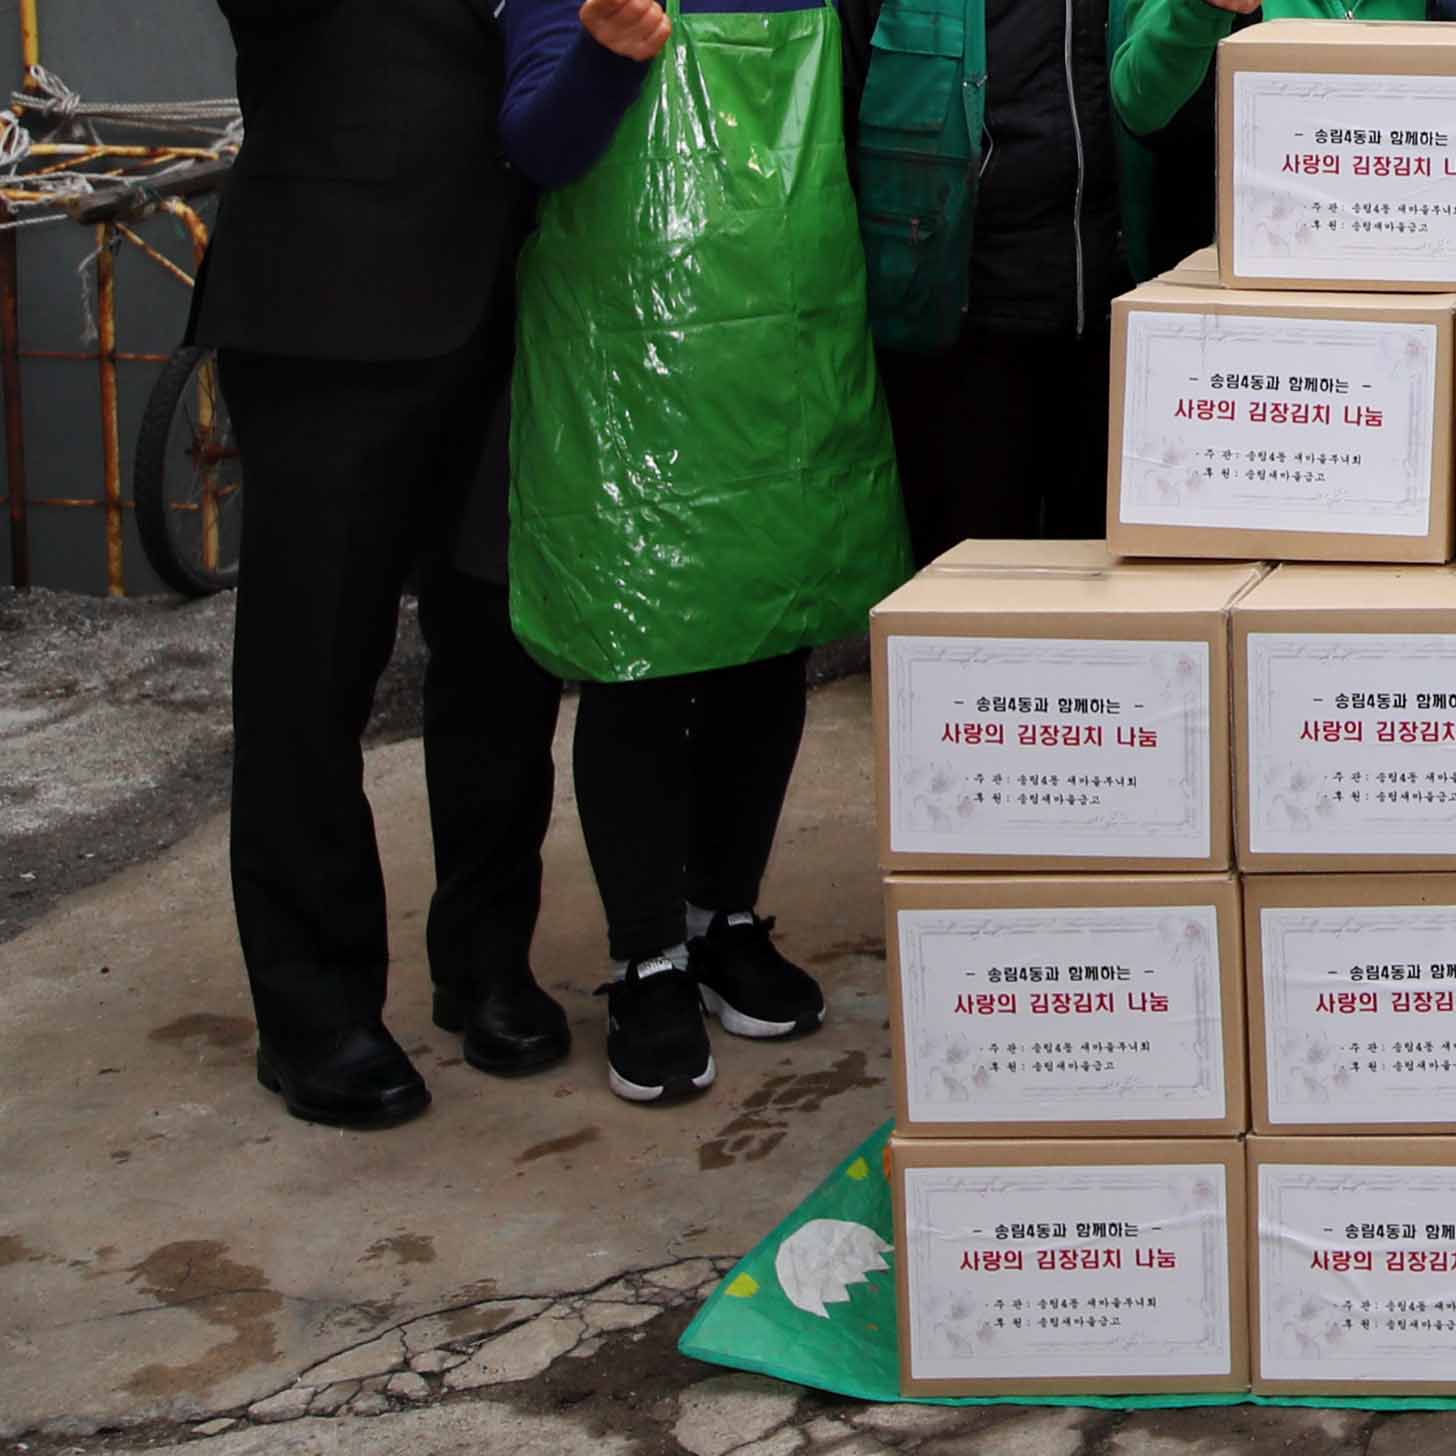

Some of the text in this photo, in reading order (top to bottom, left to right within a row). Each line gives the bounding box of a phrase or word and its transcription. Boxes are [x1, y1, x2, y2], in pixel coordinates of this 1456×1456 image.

[1282, 154, 1339, 174] 사랑의
[1353, 156, 1430, 176] 김장김치
[1177, 399, 1382, 427] 사랑의 김장김치 나눔
[977, 697, 1120, 714] 송림4동과 함께하는
[942, 723, 1157, 748] 사랑의 김장김치 나눔
[1301, 721, 1362, 742] 사랑의
[955, 992, 1168, 1015] 사랑의 김장김치 나눔
[1316, 993, 1377, 1013] 사랑의
[1345, 1224, 1416, 1239] 송림4동과
[960, 1248, 1176, 1271] 사랑의 김장김치 나눔
[1311, 1251, 1372, 1272] 사랑의
